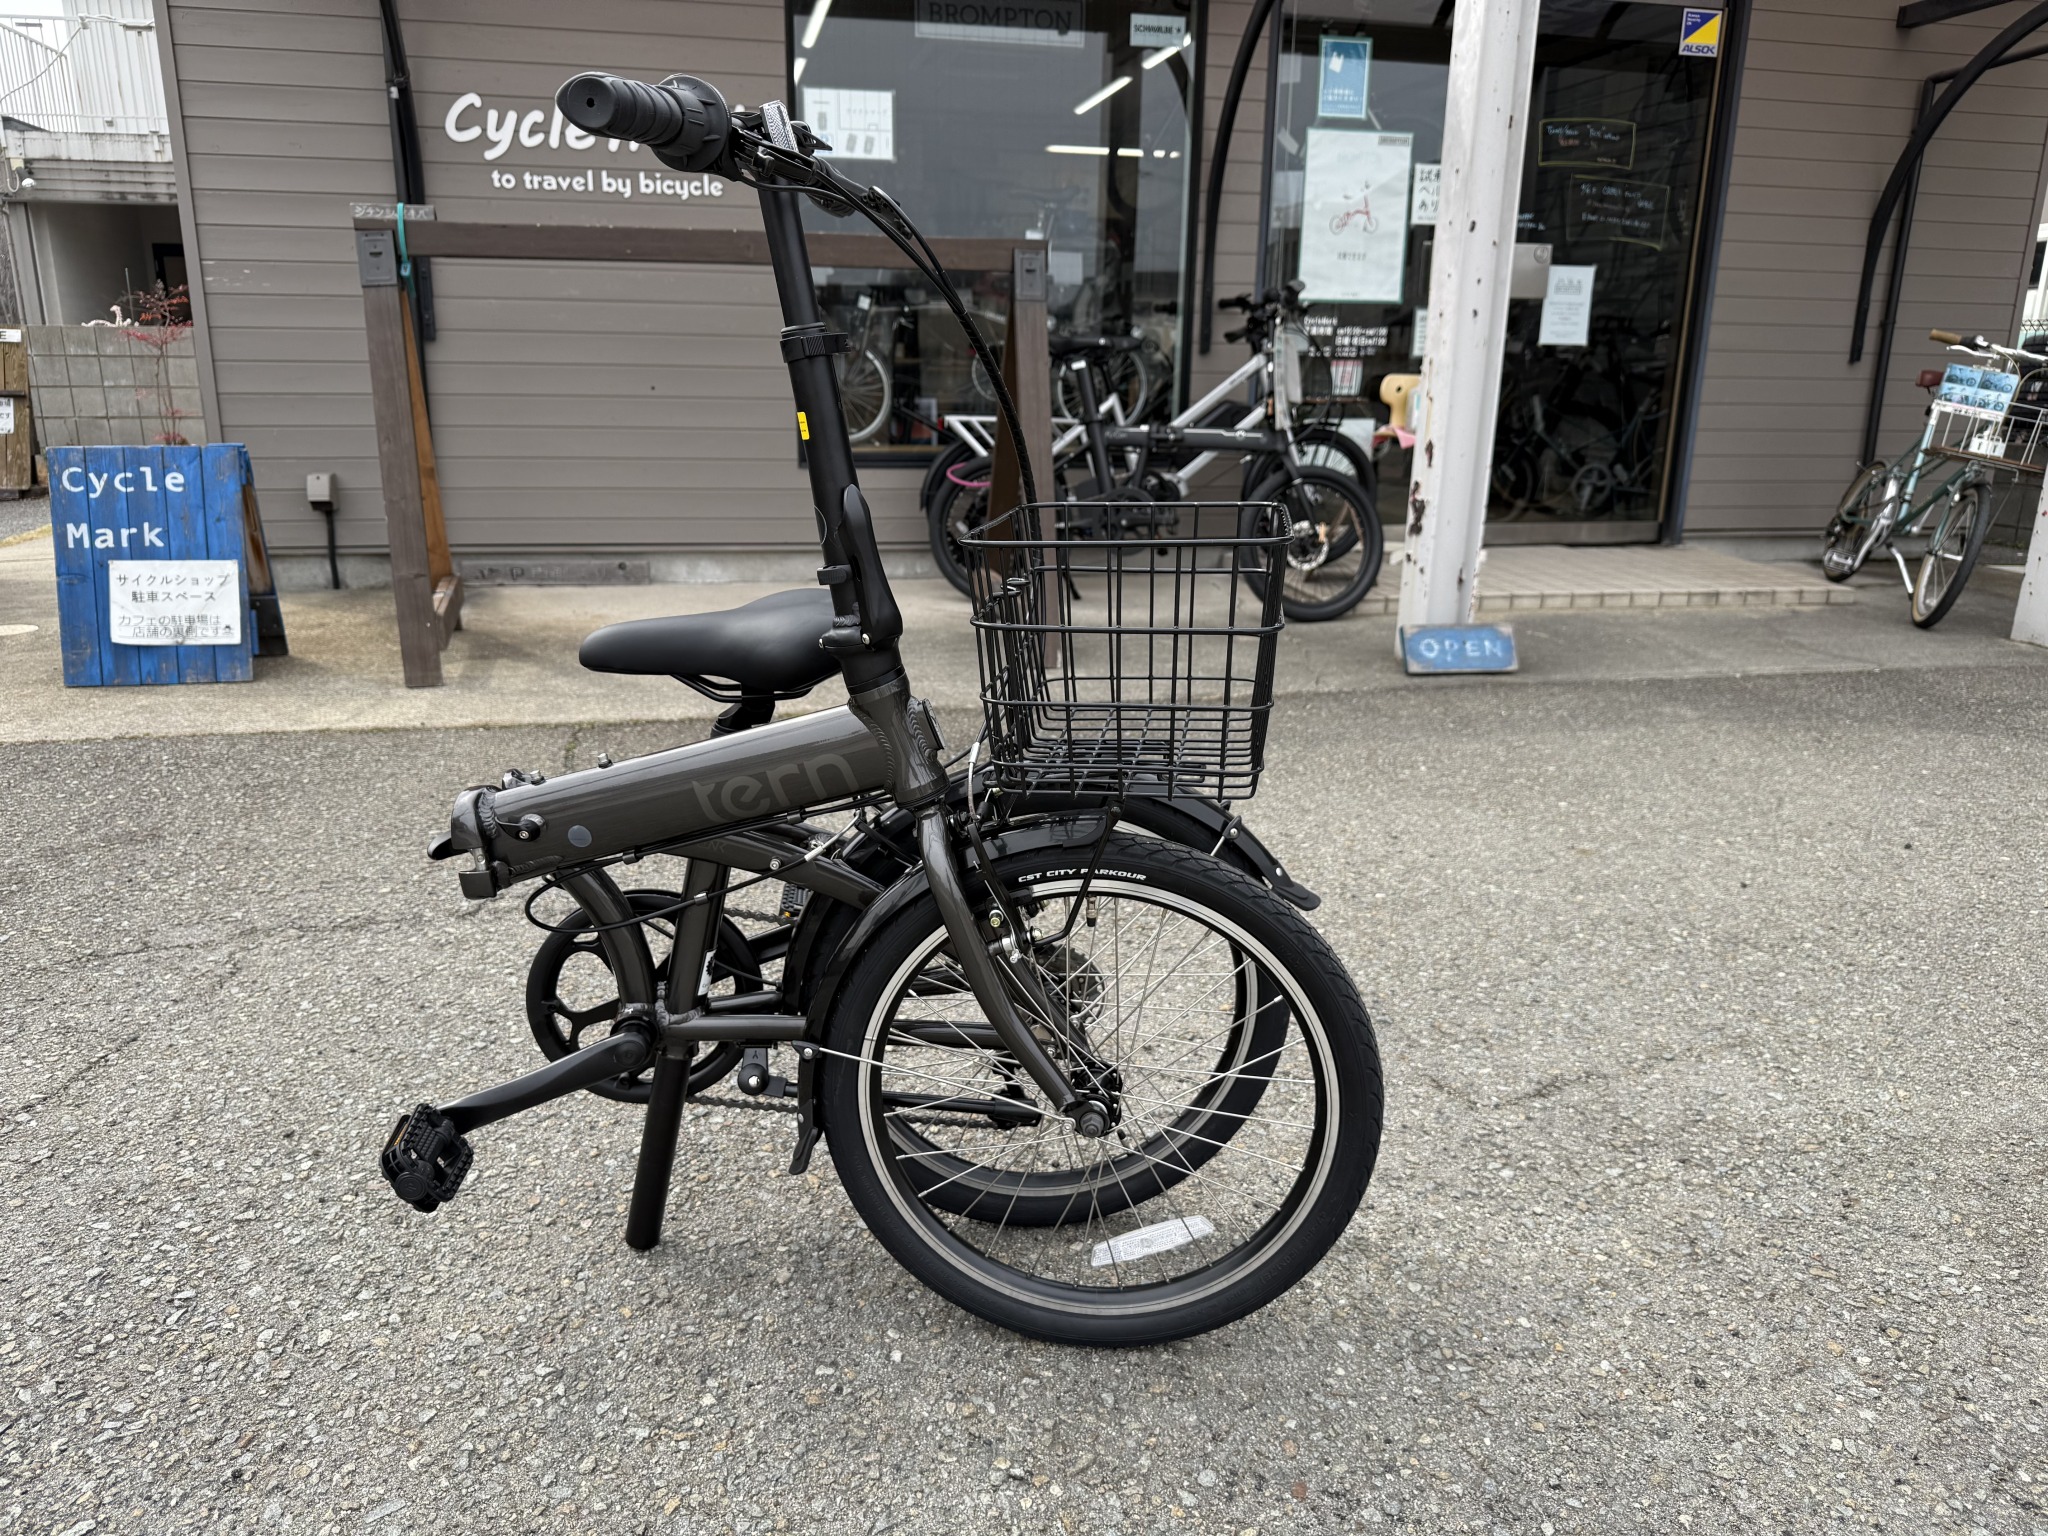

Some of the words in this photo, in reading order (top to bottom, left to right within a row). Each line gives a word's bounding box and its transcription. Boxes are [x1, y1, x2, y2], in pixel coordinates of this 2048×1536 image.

[928, 2, 1073, 31] BROMPTON
[1681, 44, 1716, 55] ALSOK
[491, 170, 516, 189] to
[523, 169, 594, 192] travel
[601, 170, 632, 198] by
[639, 172, 724, 200] bicycle
[61, 466, 185, 499] Cycle
[66, 521, 165, 549] Mark
[117, 574, 231, 586] サイクルショップ
[132, 591, 217, 603] 駐車スペース
[1420, 638, 1503, 662] OPEN
[692, 753, 860, 824] tern
[1018, 872, 1042, 882] CST
[1046, 868, 1077, 877] CITY
